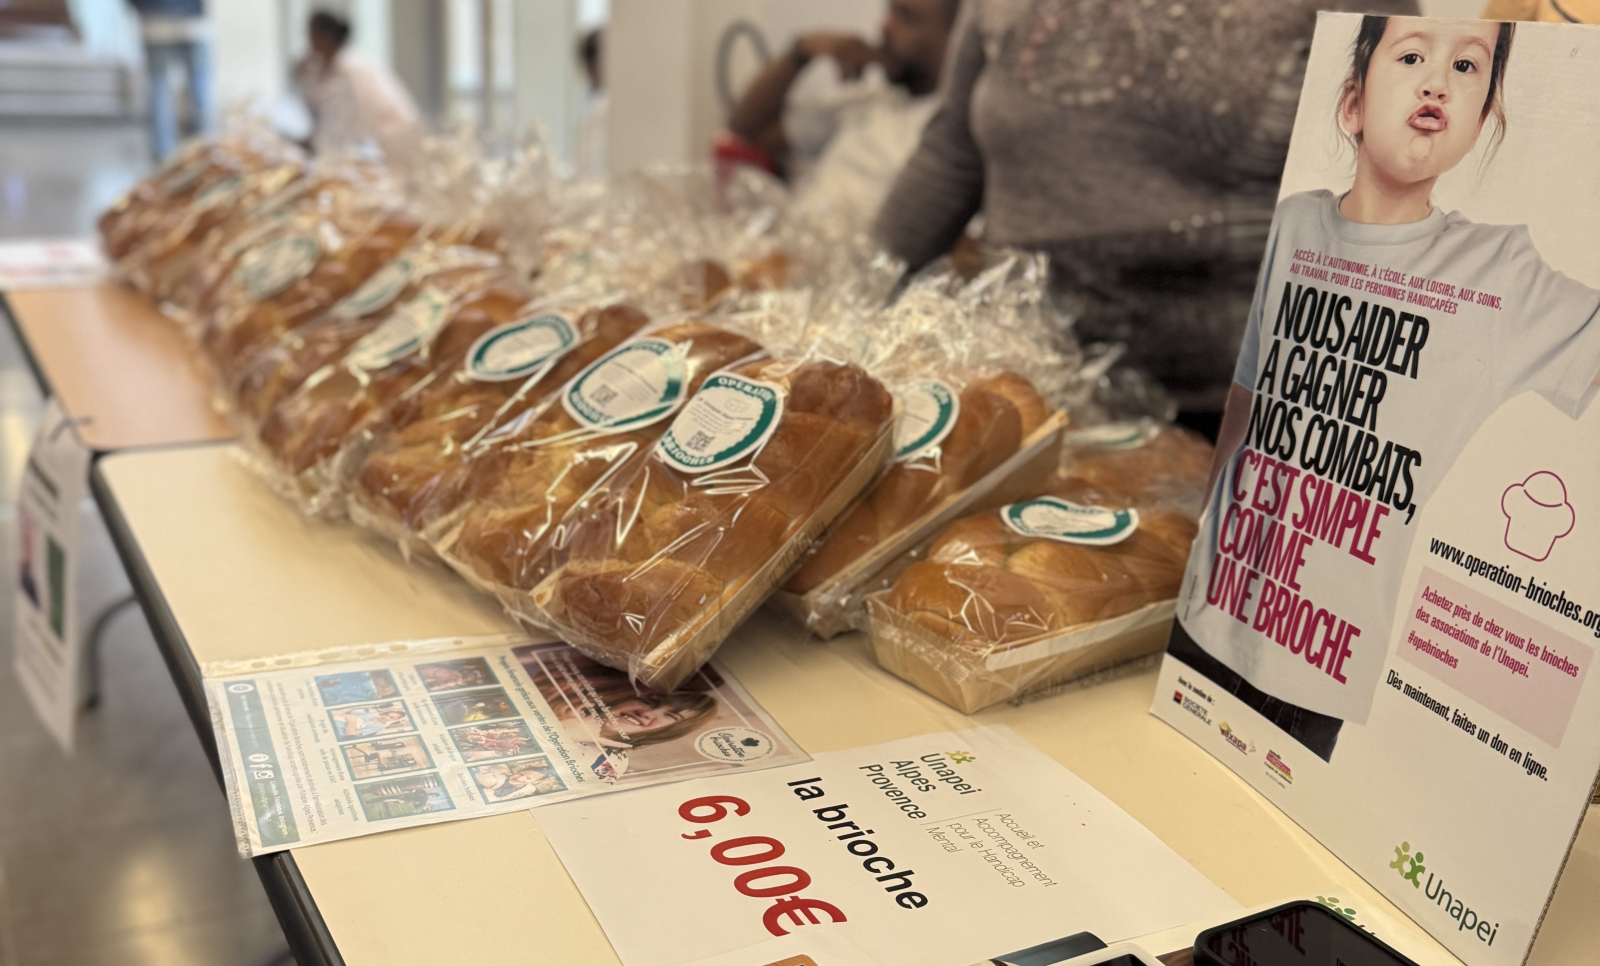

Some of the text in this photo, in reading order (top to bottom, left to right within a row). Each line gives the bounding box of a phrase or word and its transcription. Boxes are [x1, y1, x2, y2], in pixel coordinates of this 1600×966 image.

[1290, 263, 1458, 315] AU TRAVAIL POUR LES PERSONNES HANDICAPÉES
[1293, 249, 1502, 311] ACCÈS À L'AUTONOMIE, À L'ÉCOLE, AUX LOISIRS, AUX SOINS,
[1273, 281, 1430, 380] NOUS AIDER
[1257, 339, 1388, 432] A GAGNER
[1245, 393, 1422, 525] NOS COMBATS,
[1233, 449, 1390, 566] C'EST SIMPLE
[1219, 502, 1313, 592] COMME
[1206, 553, 1361, 685] UNE BRIOCHE
[1429, 537, 1600, 639] www.operation-brioches.org
[1407, 630, 1459, 669] #opebrioches
[1415, 606, 1529, 679] des associations de l'Unapei.
[1422, 586, 1580, 678] Achetez près de chez vous les brioches
[541, 724, 555, 732] de
[1182, 702, 1212, 726] GENERALE
[1184, 696, 1208, 716] SOCIETE
[1386, 669, 1548, 782] Dès maintenant, faites un don en ligne.
[542, 731, 574, 760] l'Opération
[563, 759, 589, 782] Brioches
[889, 760, 937, 793] Alpes
[920, 753, 982, 795] Unapei
[859, 764, 927, 819] Provence
[787, 776, 929, 910] la brioche
[926, 827, 963, 853] Mental
[947, 823, 1025, 888] pour le Handicap
[971, 818, 1058, 887] Accompagnement
[995, 813, 1046, 850] Accueil et
[678, 795, 847, 937] 6,00€
[1425, 872, 1500, 946] Unapei
